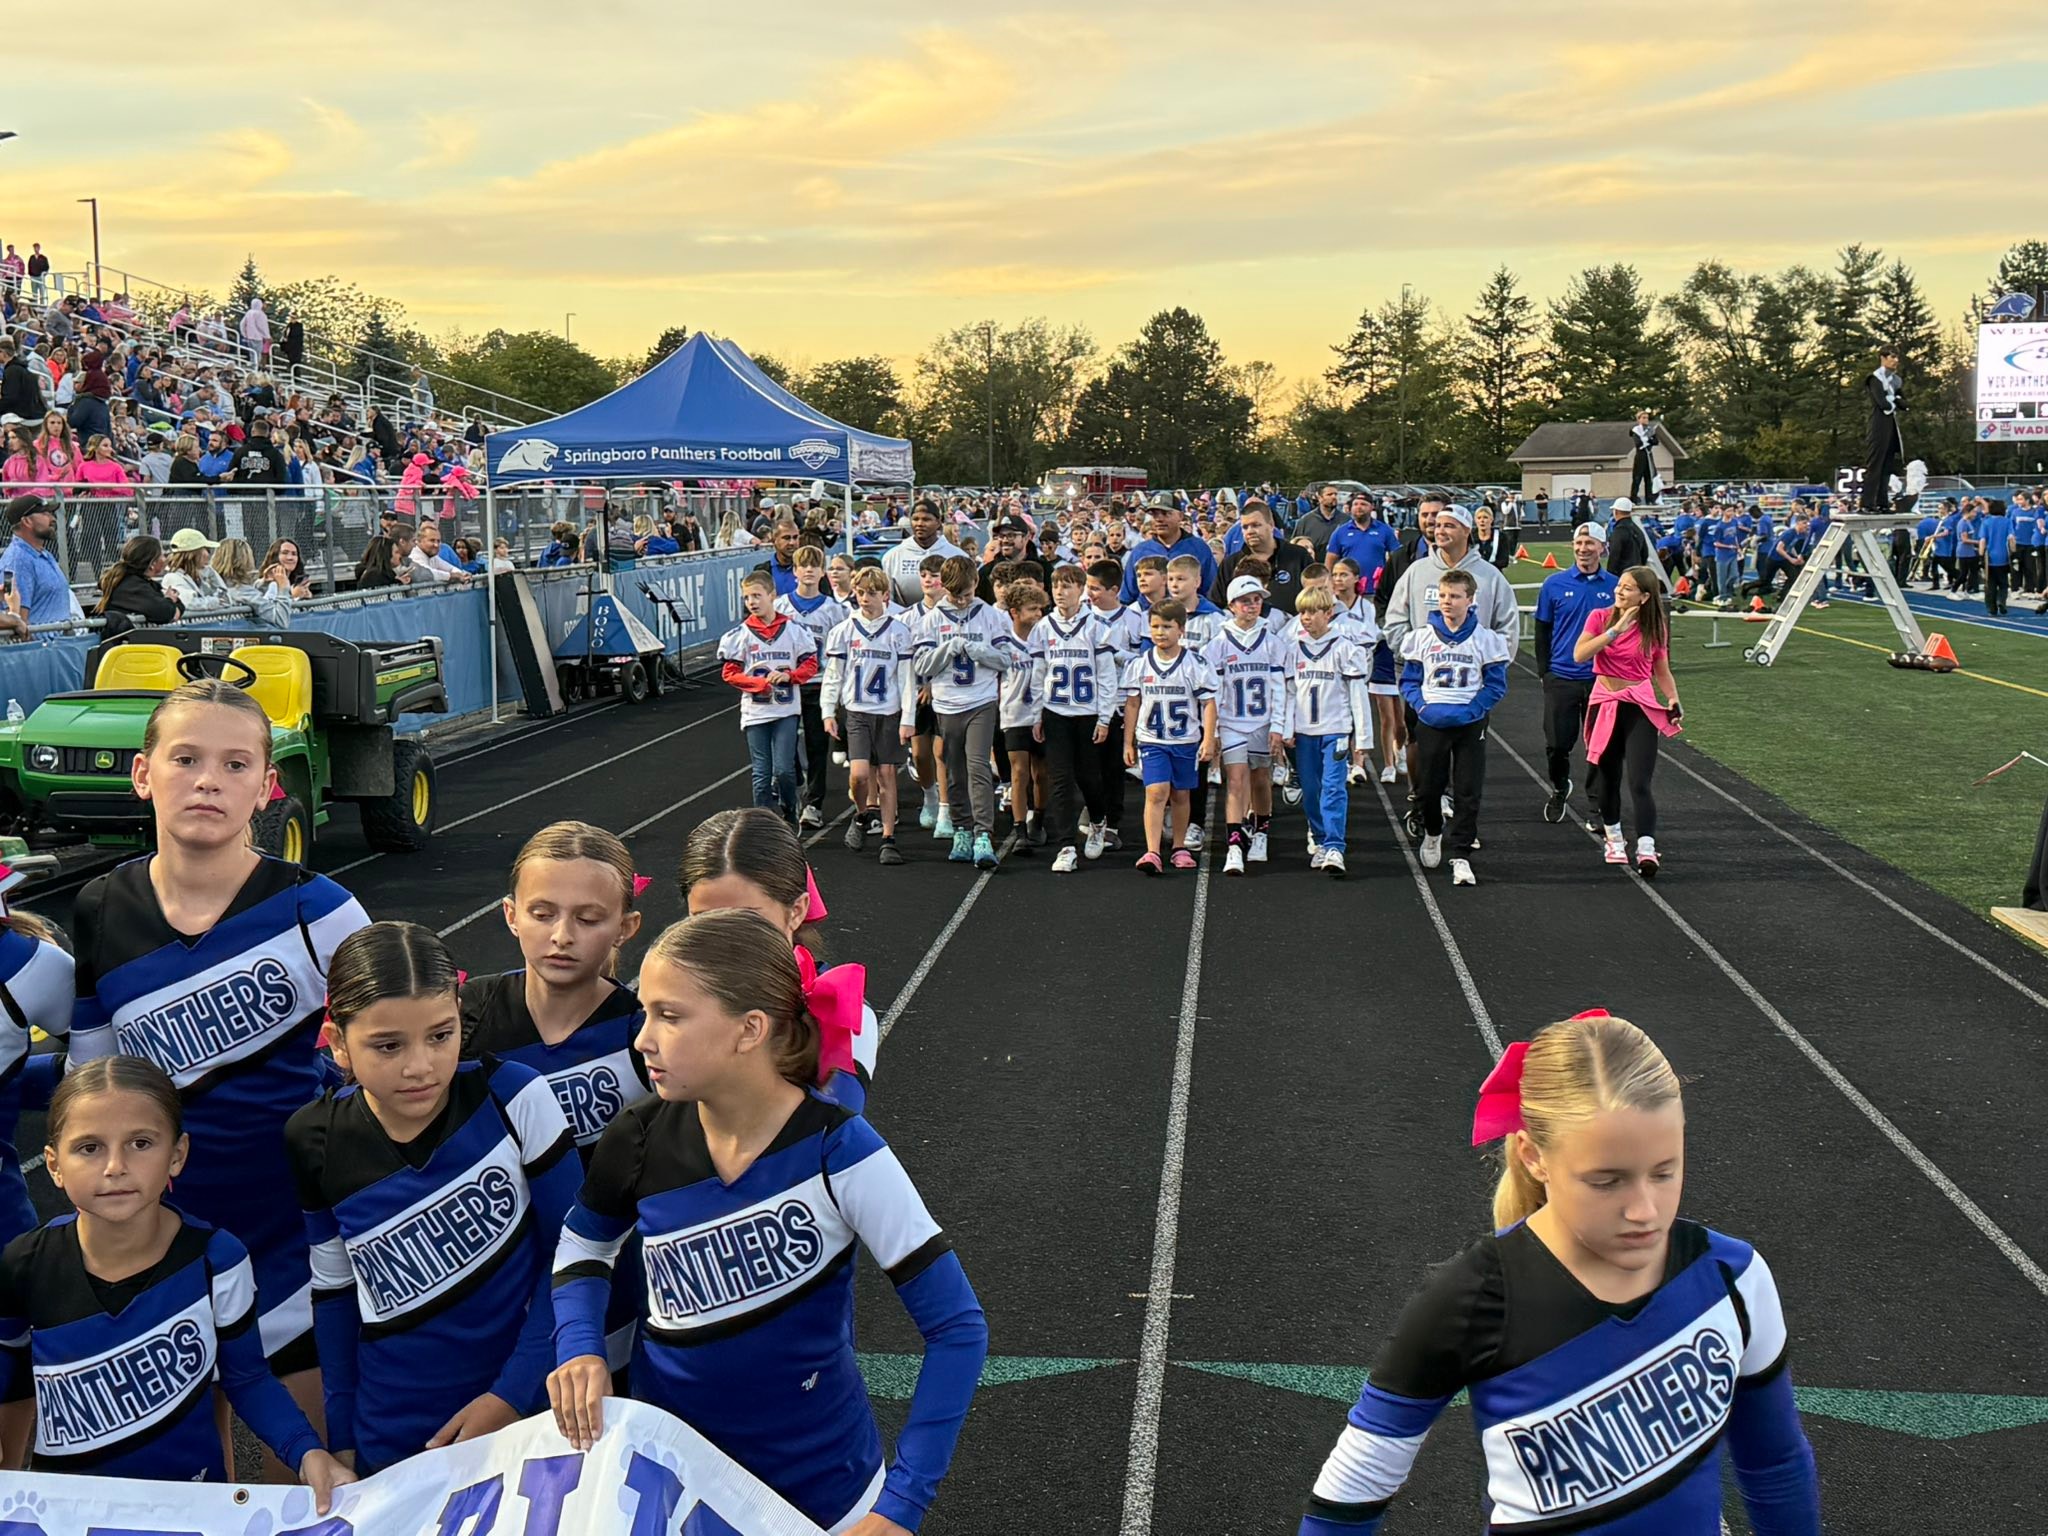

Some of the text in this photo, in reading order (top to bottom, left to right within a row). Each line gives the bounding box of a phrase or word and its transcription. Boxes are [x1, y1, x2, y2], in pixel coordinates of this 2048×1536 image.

[564, 446, 647, 465] Springboro
[651, 446, 717, 461] Panthers
[721, 447, 781, 461] Football
[591, 606, 609, 649] BORO
[853, 664, 888, 704] 14
[952, 651, 976, 687] 9
[1051, 664, 1095, 705] 26
[1232, 677, 1267, 718] 13
[1309, 684, 1320, 725] 1
[1147, 700, 1189, 740] 45
[118, 958, 299, 1077] PANTHERS
[350, 1165, 519, 1316] PANTHERS
[645, 1200, 823, 1319] PANTHERS
[36, 1320, 206, 1447] PANTHERS
[1505, 1328, 1736, 1514] PANTHERS
